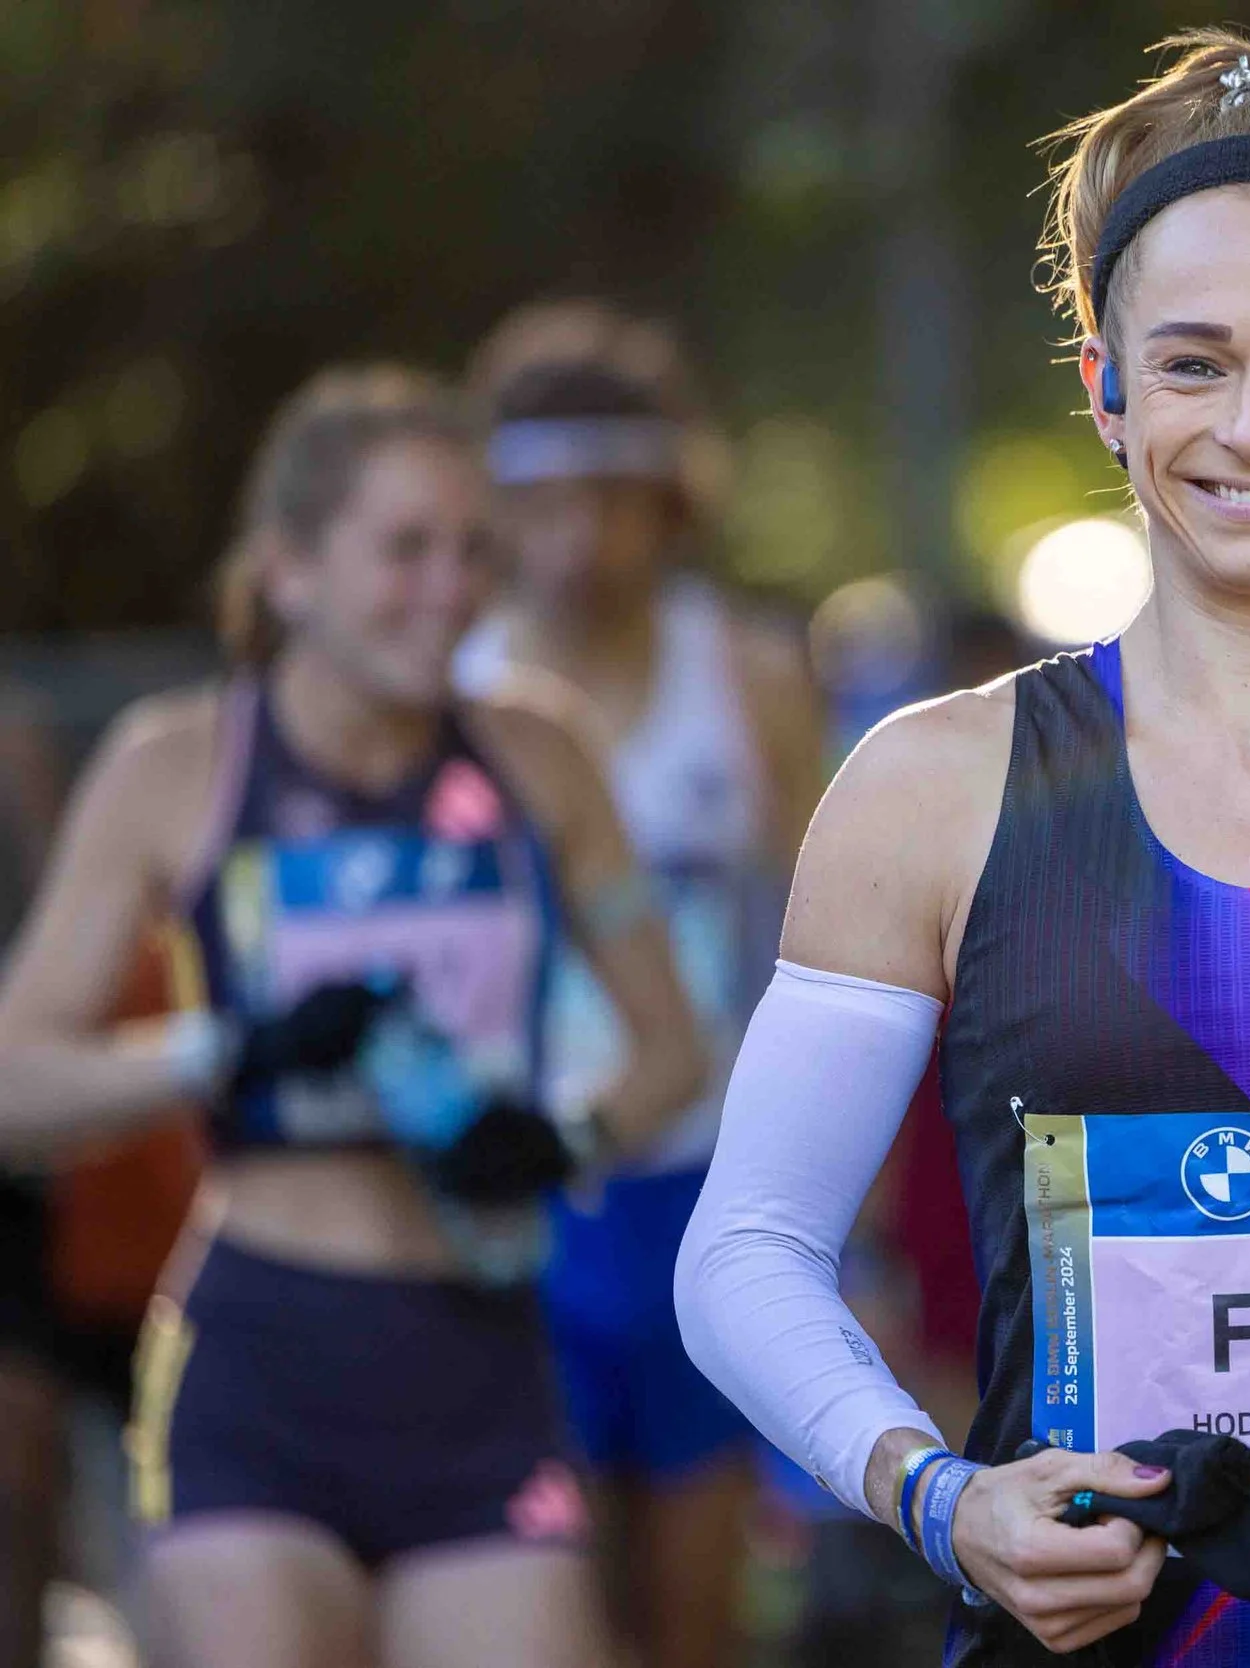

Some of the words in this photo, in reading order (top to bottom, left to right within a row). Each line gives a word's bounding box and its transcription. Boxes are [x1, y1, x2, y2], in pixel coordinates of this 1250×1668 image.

[1060, 1246, 1075, 1287] 2024
[1062, 1290, 1080, 1376] September
[1047, 1379, 1061, 1405] 50.
[1064, 1379, 1079, 1405] 29.
